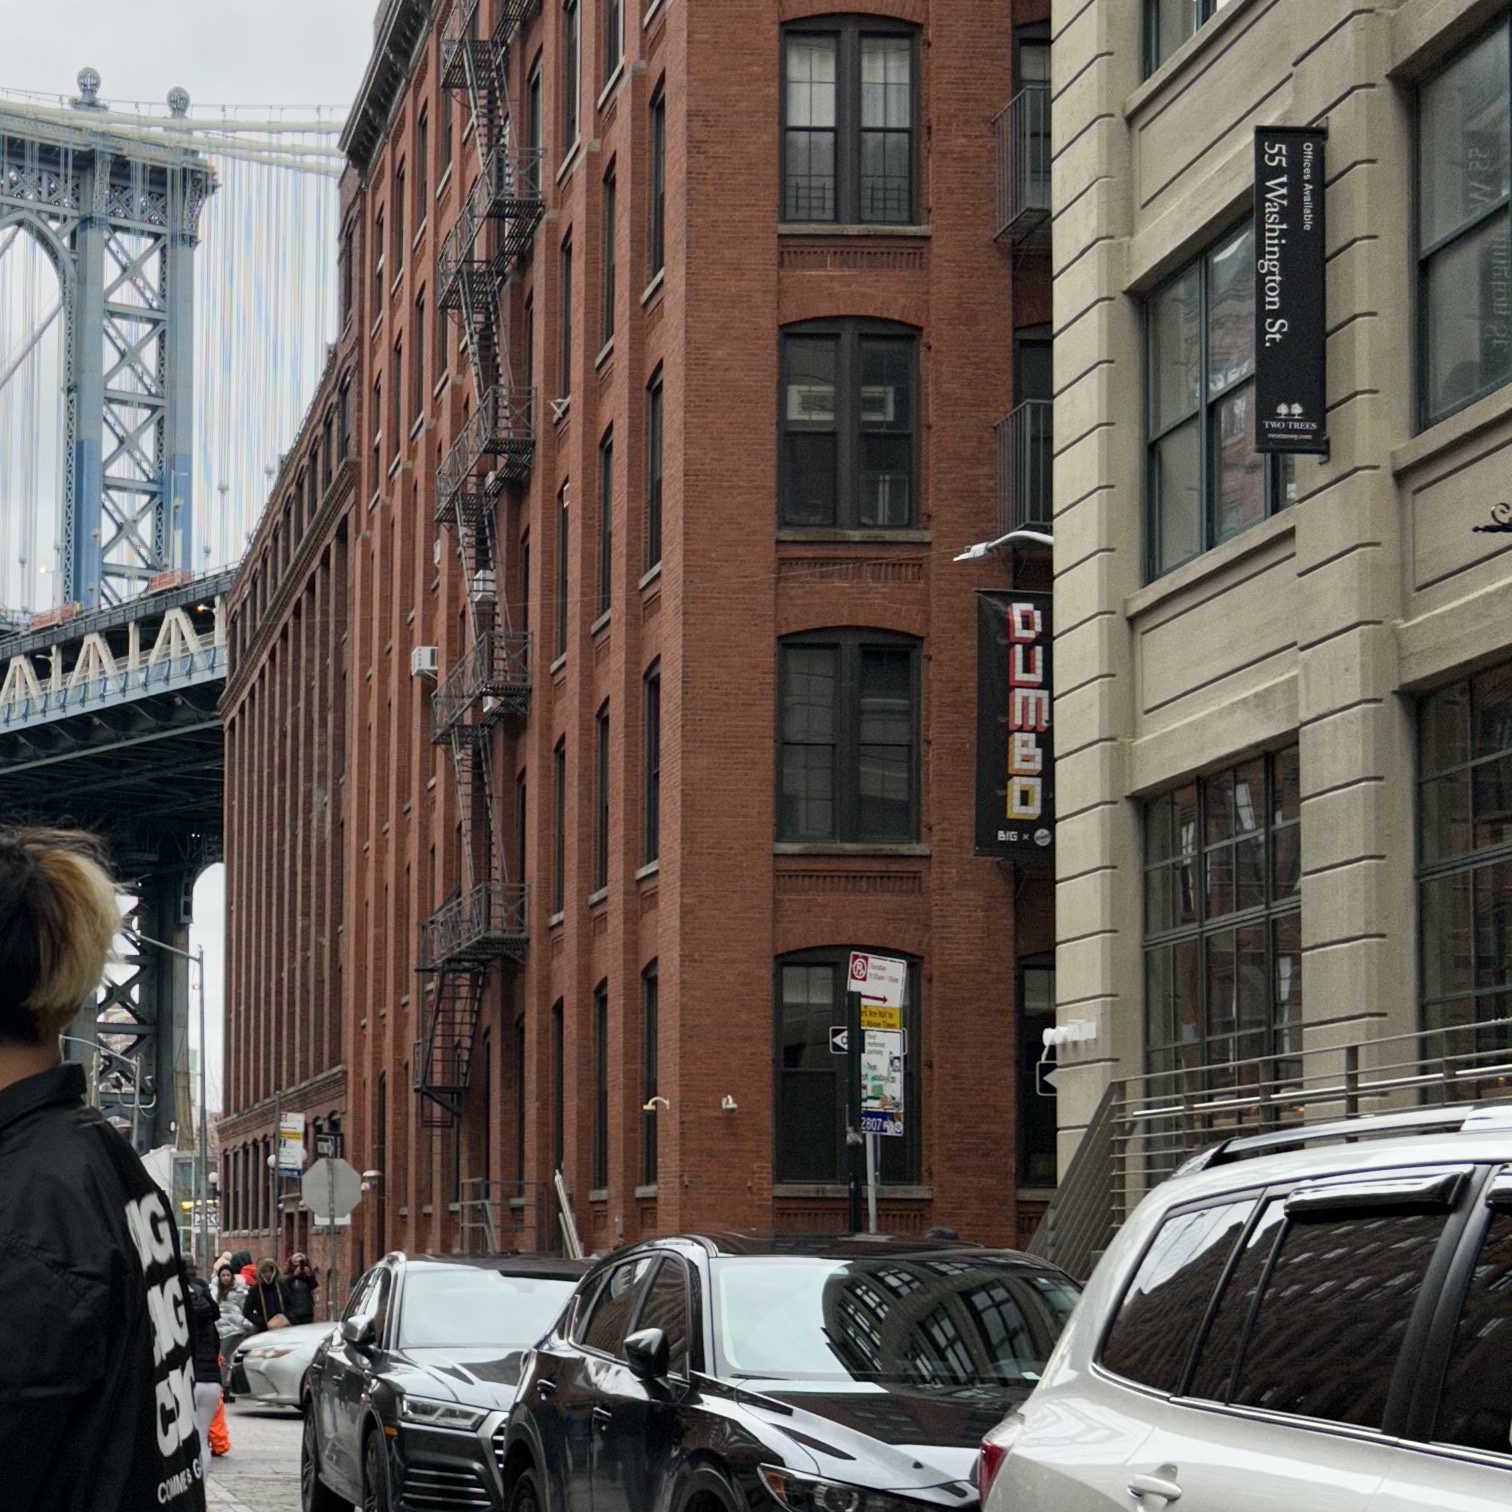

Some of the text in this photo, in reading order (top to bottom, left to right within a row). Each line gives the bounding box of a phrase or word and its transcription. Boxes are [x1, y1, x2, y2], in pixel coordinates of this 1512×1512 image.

[1303, 142, 1313, 231] Offices Available
[1257, 141, 1288, 348] 55 Washington St.
[1263, 420, 1317, 430] TWO TREES
[1007, 602, 1051, 820] DUMBO
[998, 830, 1018, 841] BIG
